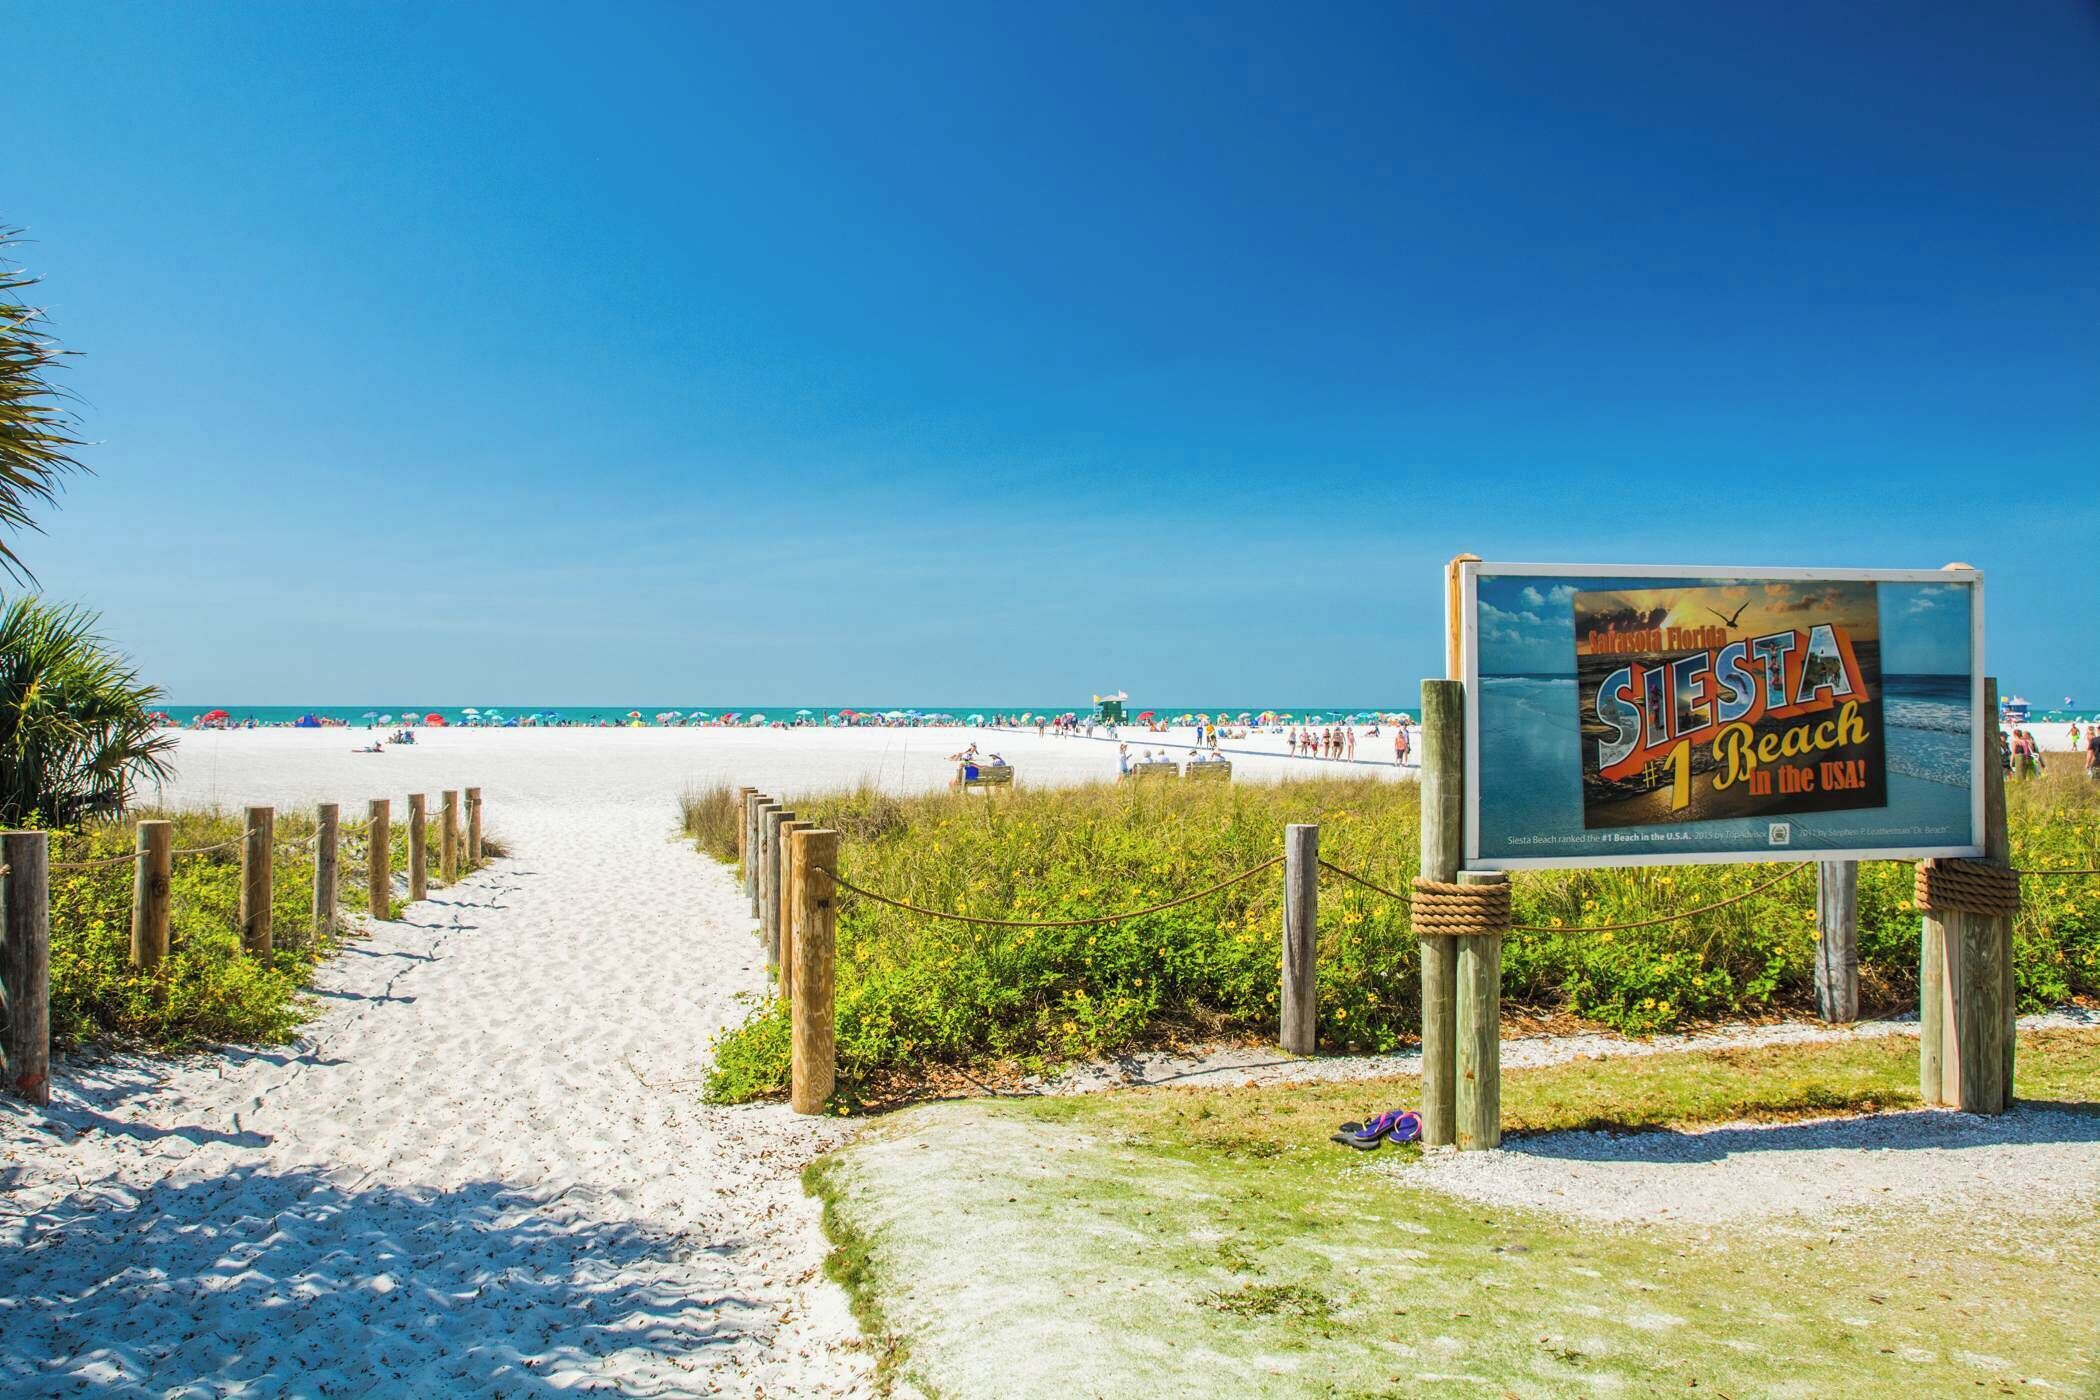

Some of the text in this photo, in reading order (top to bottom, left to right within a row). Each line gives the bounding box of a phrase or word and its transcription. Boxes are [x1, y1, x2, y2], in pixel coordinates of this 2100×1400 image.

[1666, 625, 1727, 651] Florida
[1596, 623, 1858, 772] SIESTA
[1642, 700, 1869, 811] #1 Beach
[1749, 760, 1866, 795] in the USA!
[1507, 835, 1532, 846] Siesta
[1532, 835, 1557, 845] Beach
[1558, 834, 1586, 844] ranked
[1587, 833, 1601, 843] the
[1602, 833, 1612, 842] #1
[1614, 833, 1640, 842] Beach
[1641, 832, 1650, 842] in
[1650, 832, 1665, 841] the
[1666, 831, 1692, 841] U.S.A.
